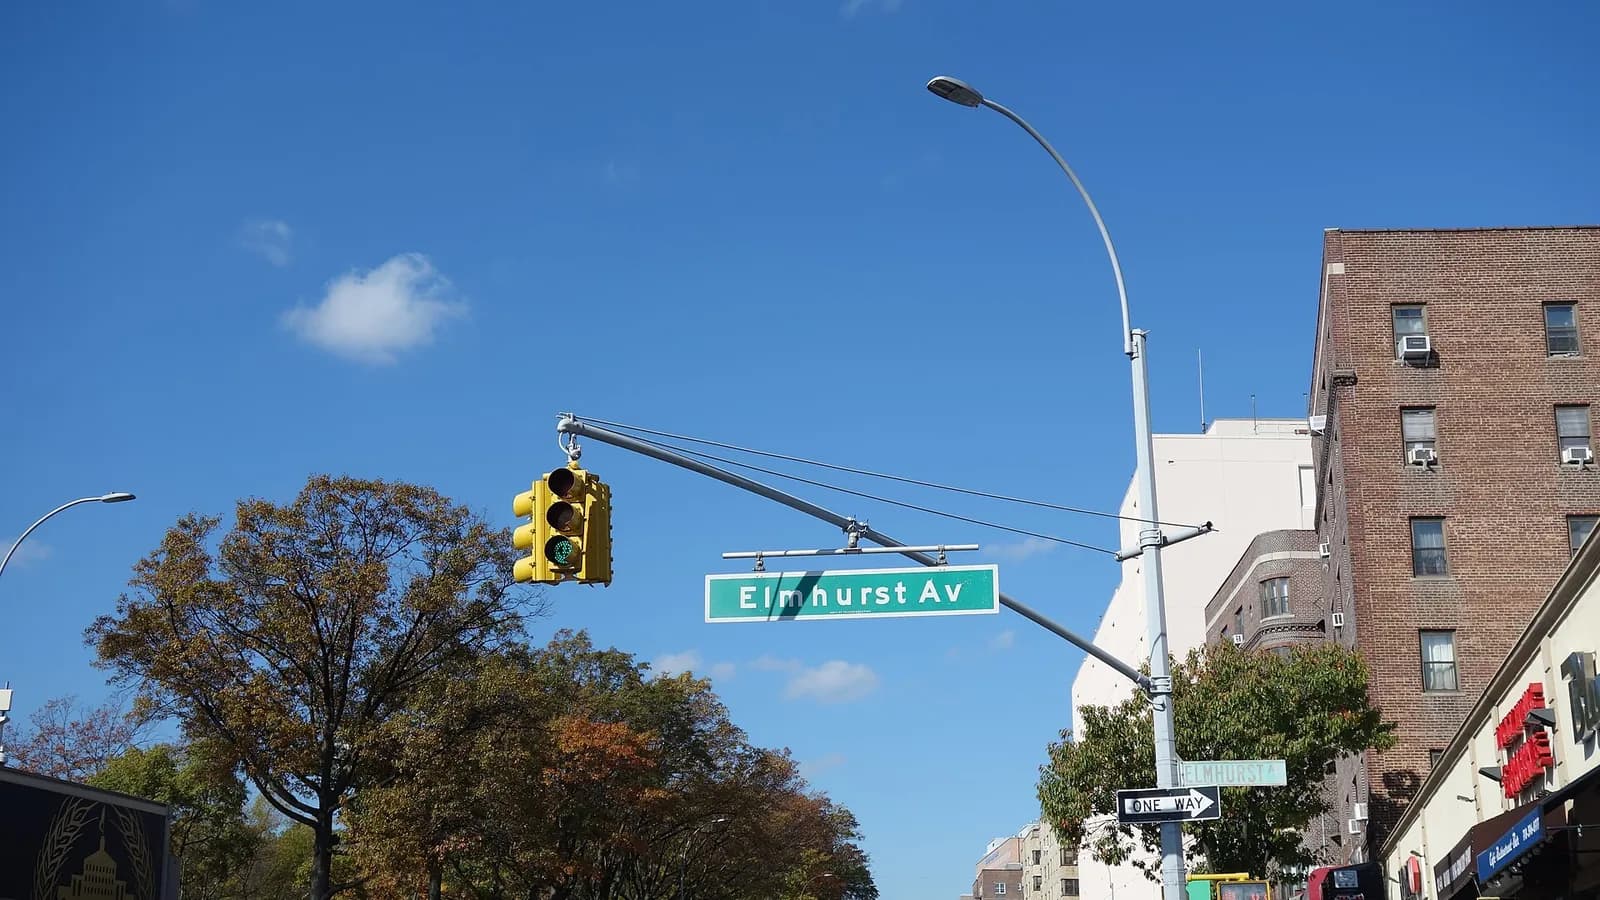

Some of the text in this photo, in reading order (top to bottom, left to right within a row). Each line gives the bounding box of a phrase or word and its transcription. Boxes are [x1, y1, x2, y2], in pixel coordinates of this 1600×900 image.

[739, 579, 963, 609] Elmhurst Av
[1185, 764, 1264, 783] ELMHURST
[1132, 796, 1205, 813] ONE WAY
